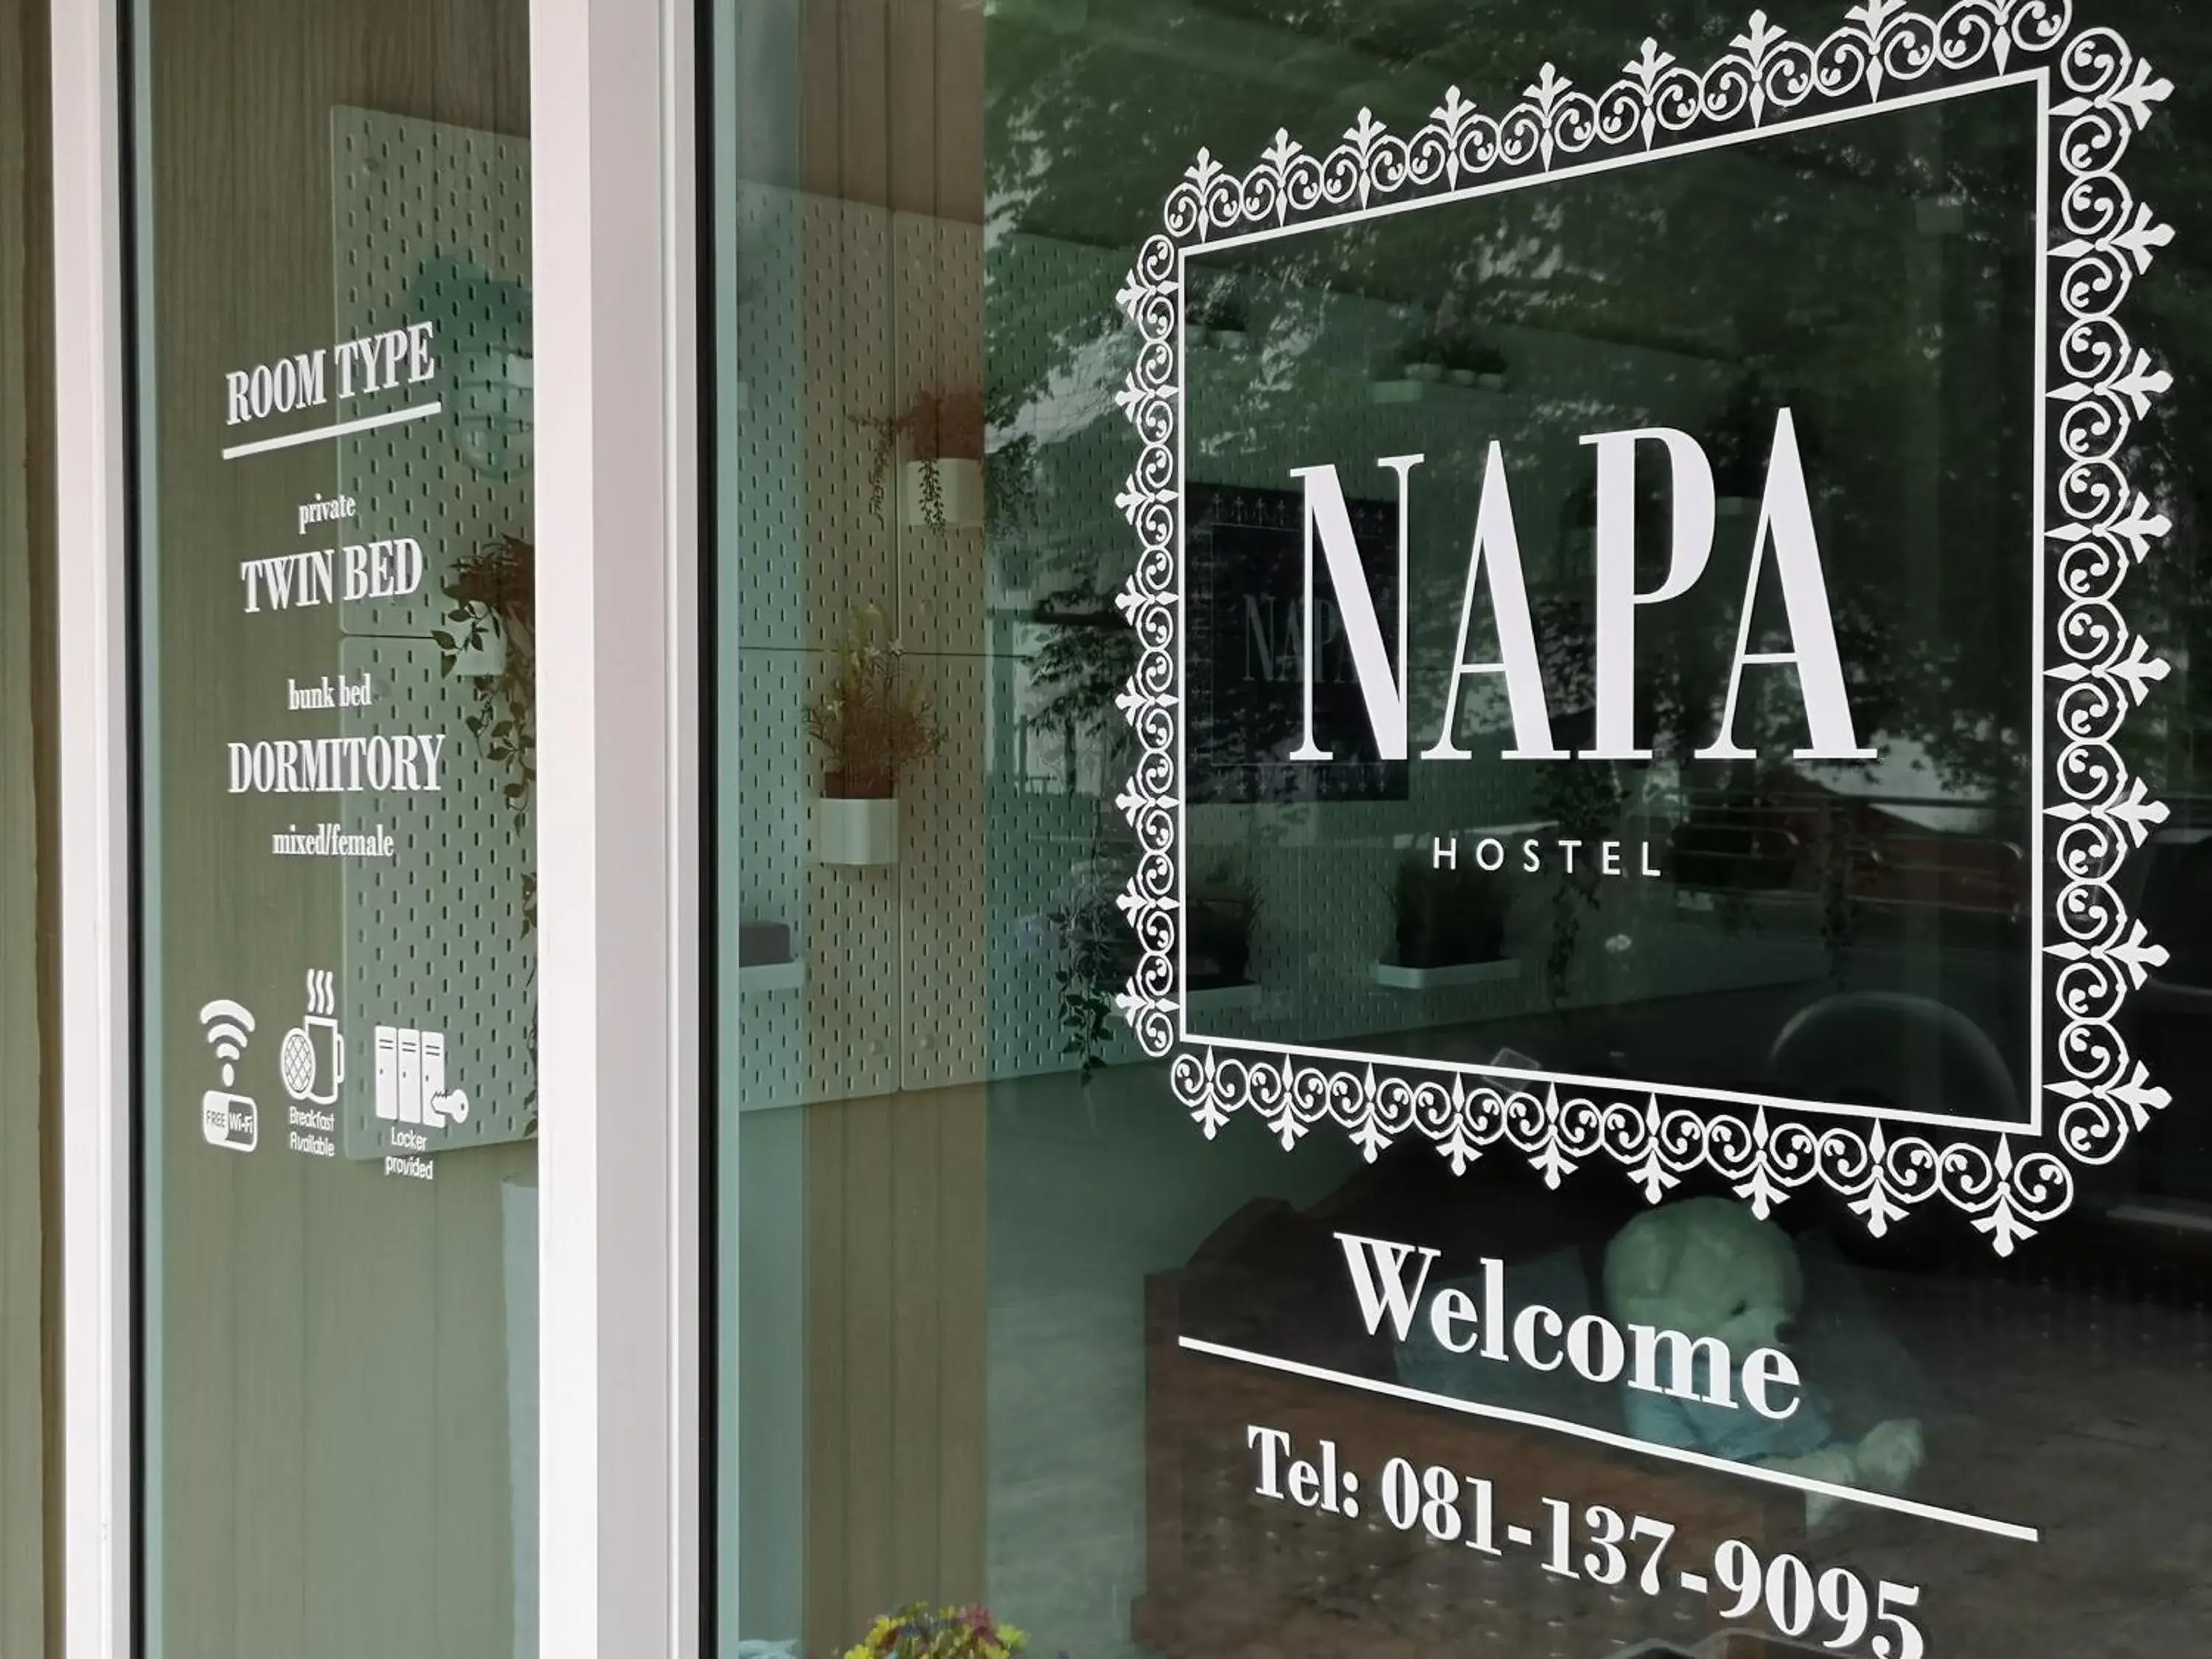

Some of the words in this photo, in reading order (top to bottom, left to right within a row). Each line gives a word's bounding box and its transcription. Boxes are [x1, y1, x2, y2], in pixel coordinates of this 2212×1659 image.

[226, 349, 327, 425] ROOM
[334, 321, 434, 399] TYPE
[299, 493, 355, 535] private
[241, 549, 334, 613] TWIN
[343, 538, 422, 601] BED
[1290, 407, 1877, 760] NAPA
[287, 676, 335, 710] bunk
[338, 673, 372, 707] bed
[227, 734, 445, 793] DORMITORY
[272, 823, 394, 857] mixed/female
[1433, 838, 1661, 877] HOSTEL
[206, 1110, 226, 1128] FREE
[229, 1112, 253, 1133] Wi-Fi
[290, 1105, 335, 1132] Breakfast
[290, 1131, 335, 1157] Available
[391, 1127, 428, 1151] Locker
[385, 1153, 434, 1180] provided
[1334, 1232, 1801, 1420] Welcome
[1247, 1425, 1360, 1520] Tel:
[1382, 1455, 1926, 1659] 081-137-9095
